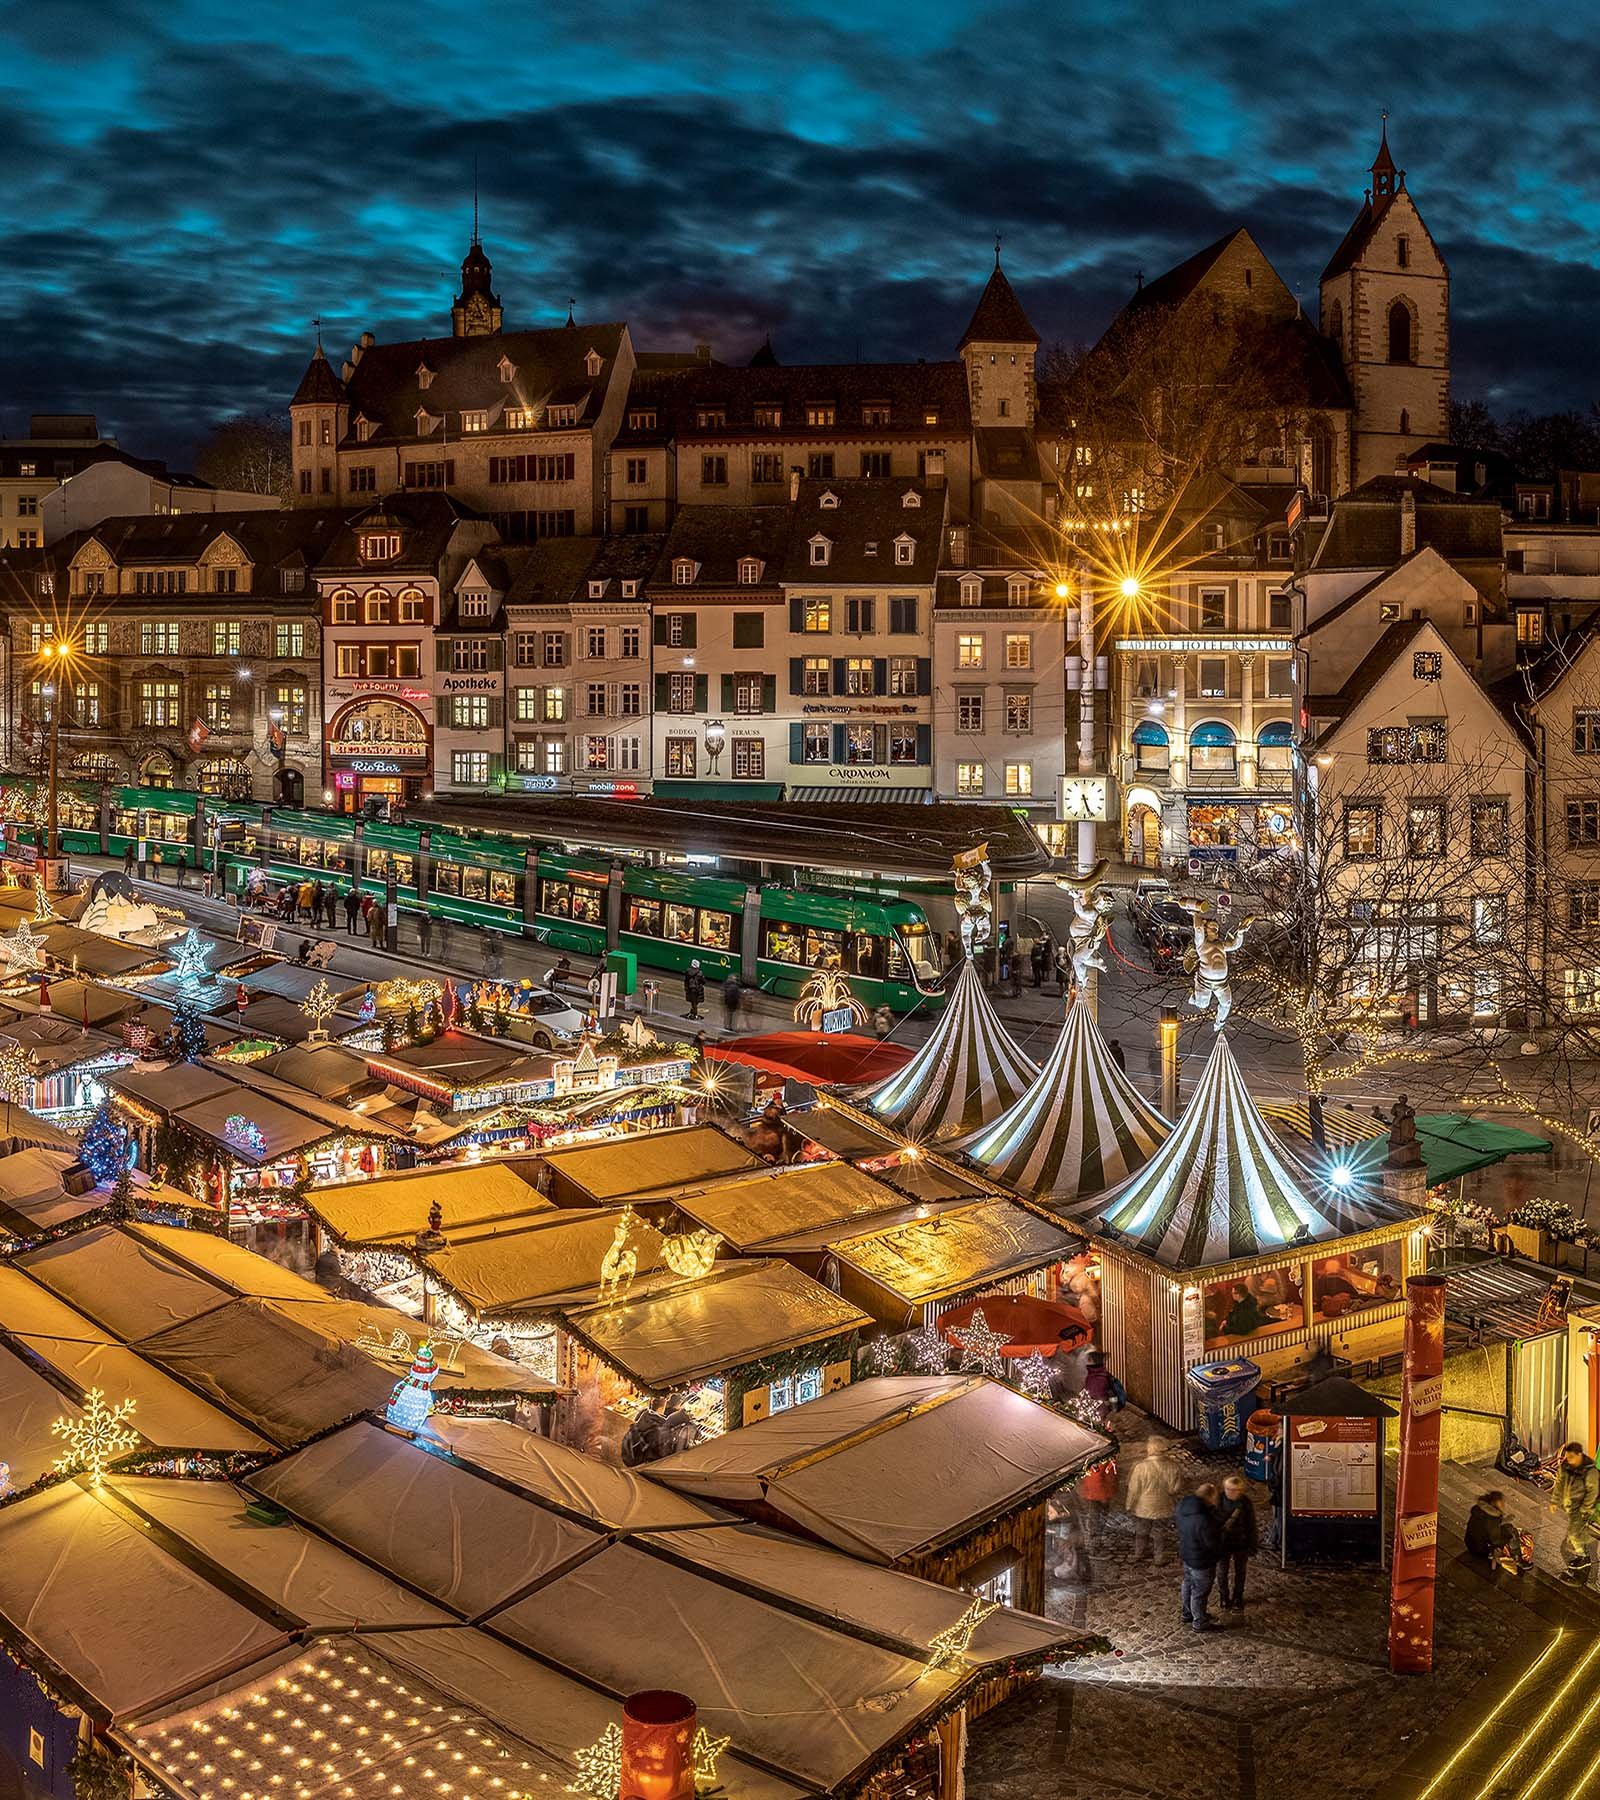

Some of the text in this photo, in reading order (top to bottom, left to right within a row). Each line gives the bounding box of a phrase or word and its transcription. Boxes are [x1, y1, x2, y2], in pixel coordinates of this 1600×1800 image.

[370, 682, 400, 691] Fourny
[442, 677, 498, 692] Apotheke
[829, 768, 891, 779] CARDAMOM
[589, 782, 635, 791] mobilezone
